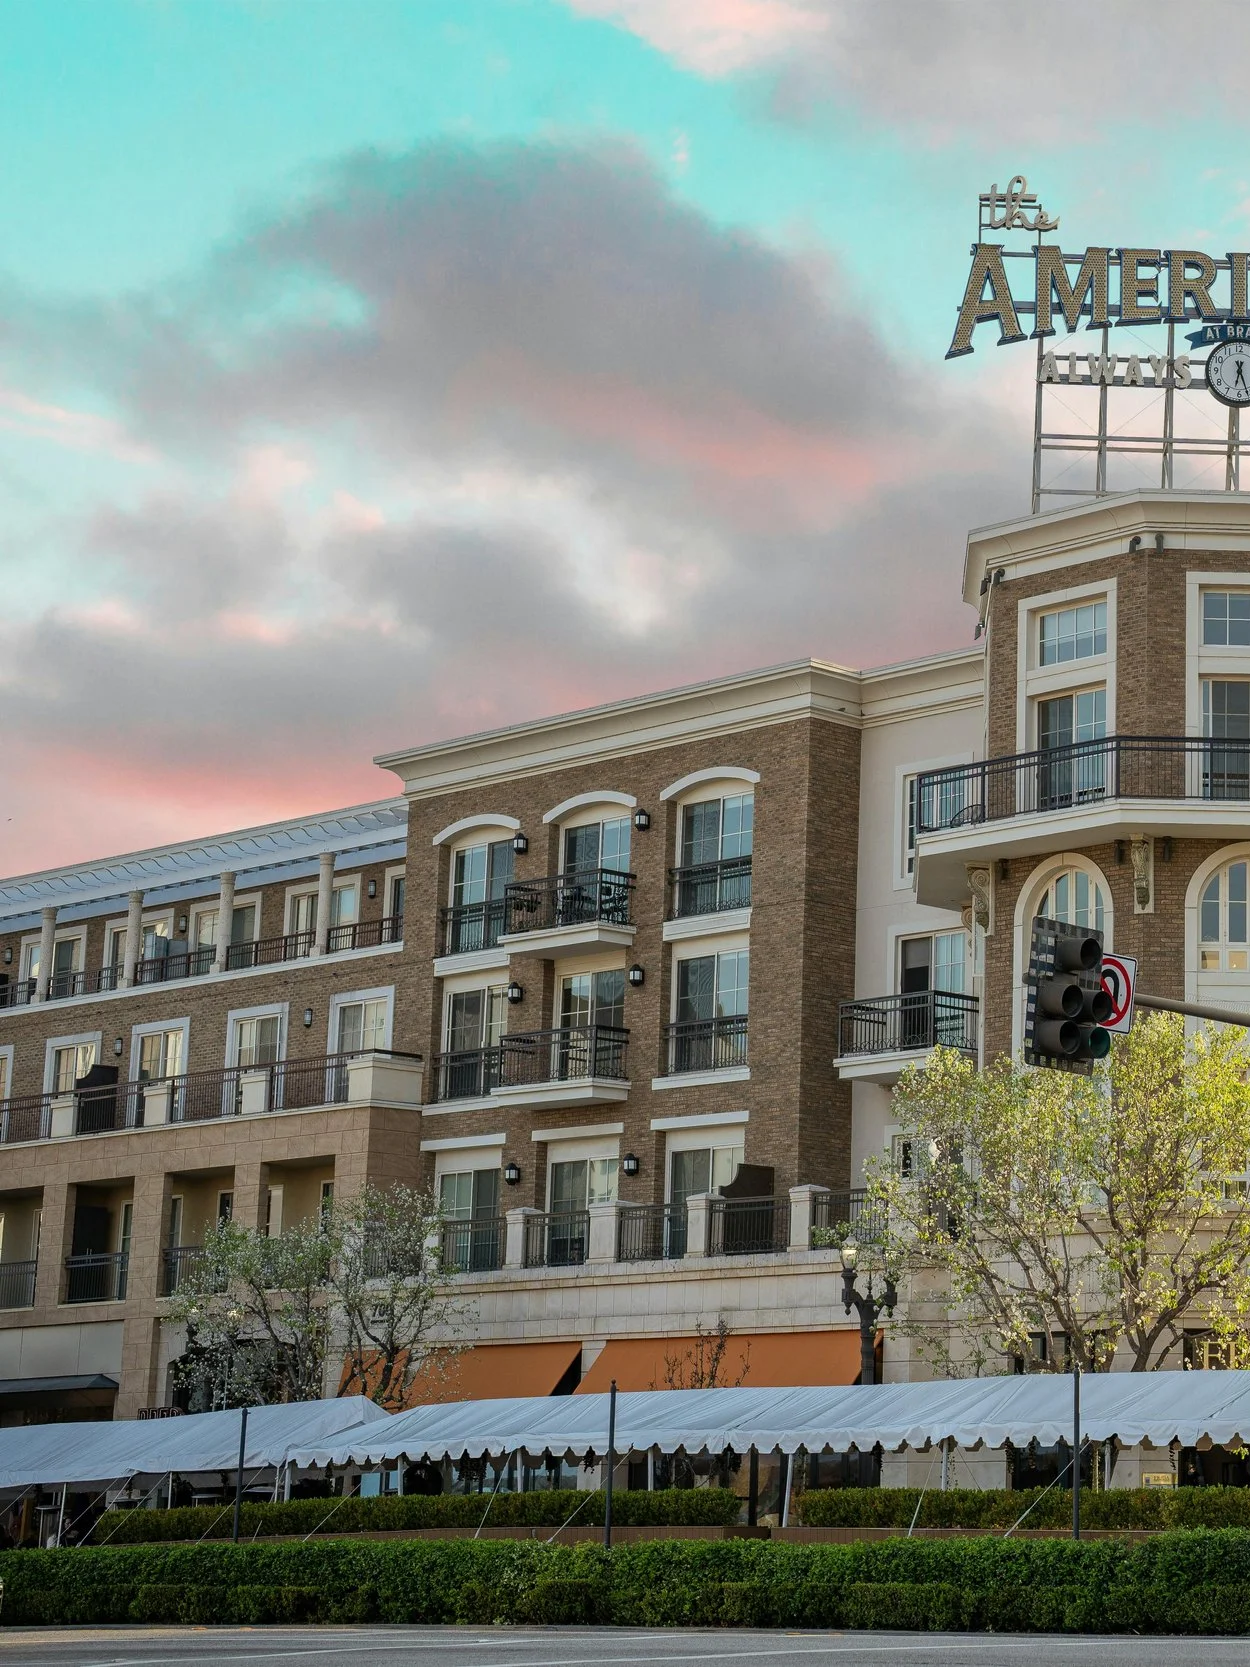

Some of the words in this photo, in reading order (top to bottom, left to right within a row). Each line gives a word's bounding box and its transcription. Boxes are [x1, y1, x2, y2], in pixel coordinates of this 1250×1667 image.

[979, 175, 1060, 231] the
[1206, 327, 1220, 340] AT
[1224, 346, 1231, 356] 11
[1039, 350, 1192, 389] ALWAYS
